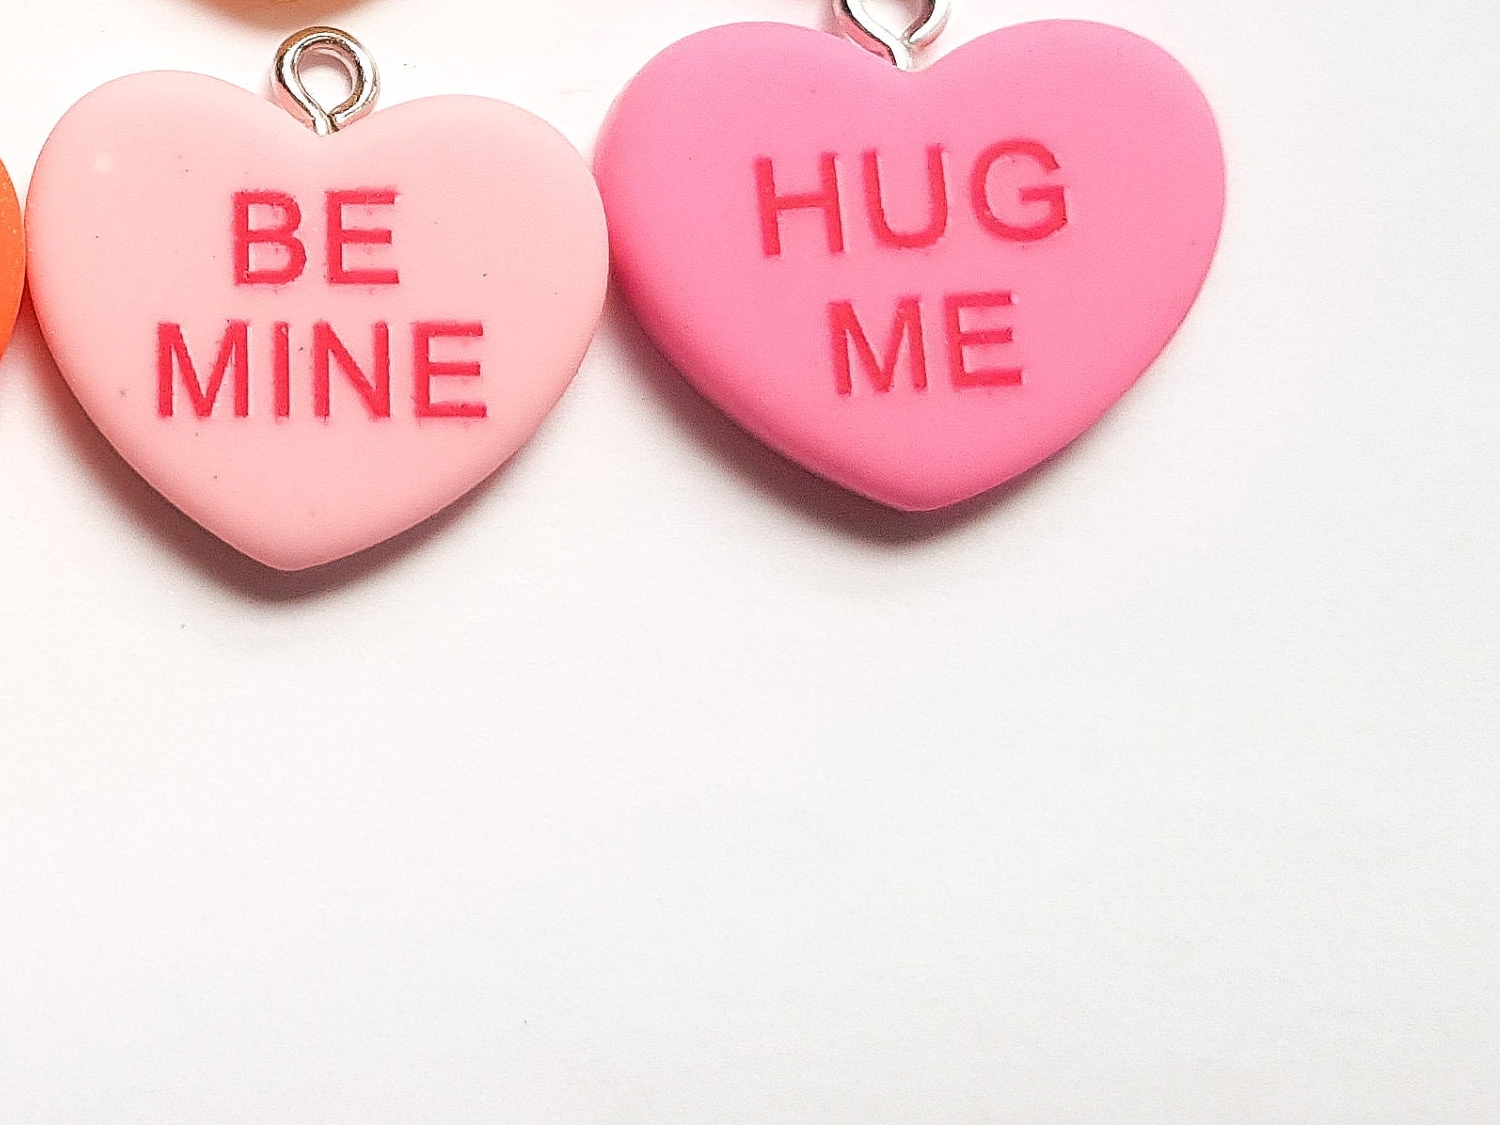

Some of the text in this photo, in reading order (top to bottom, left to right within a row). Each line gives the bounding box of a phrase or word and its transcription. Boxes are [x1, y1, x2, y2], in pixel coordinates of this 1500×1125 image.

[231, 188, 401, 288] BE
[753, 136, 1070, 260] HUG
[155, 318, 489, 422] MINE
[827, 289, 1024, 398] ME
